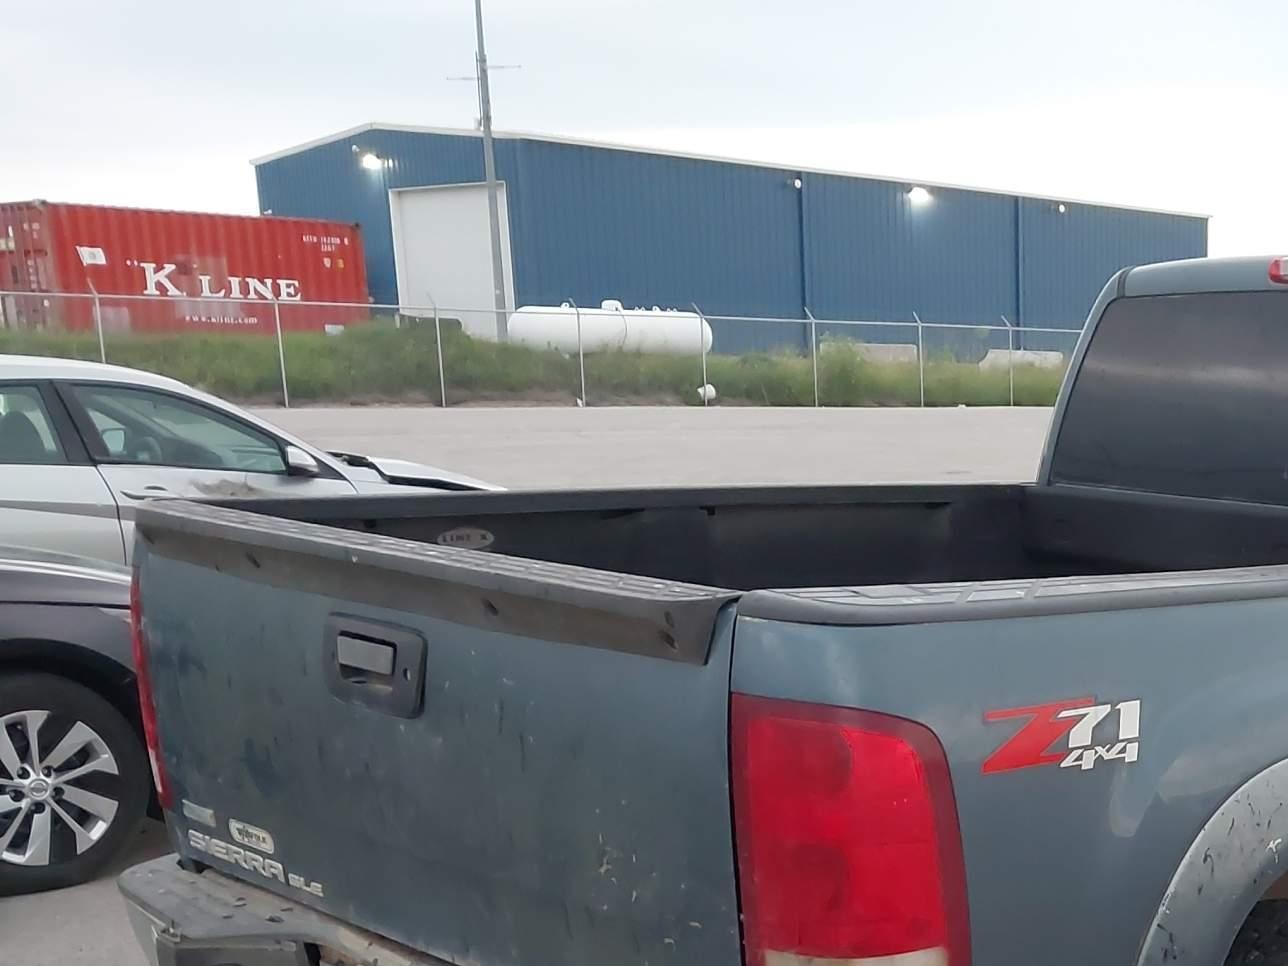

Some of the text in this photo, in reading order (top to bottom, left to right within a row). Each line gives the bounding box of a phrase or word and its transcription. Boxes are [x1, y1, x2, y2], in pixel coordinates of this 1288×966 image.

[198, 274, 301, 301] LINE
[981, 696, 1141, 775] Z71
[187, 829, 286, 883] SIERRA
